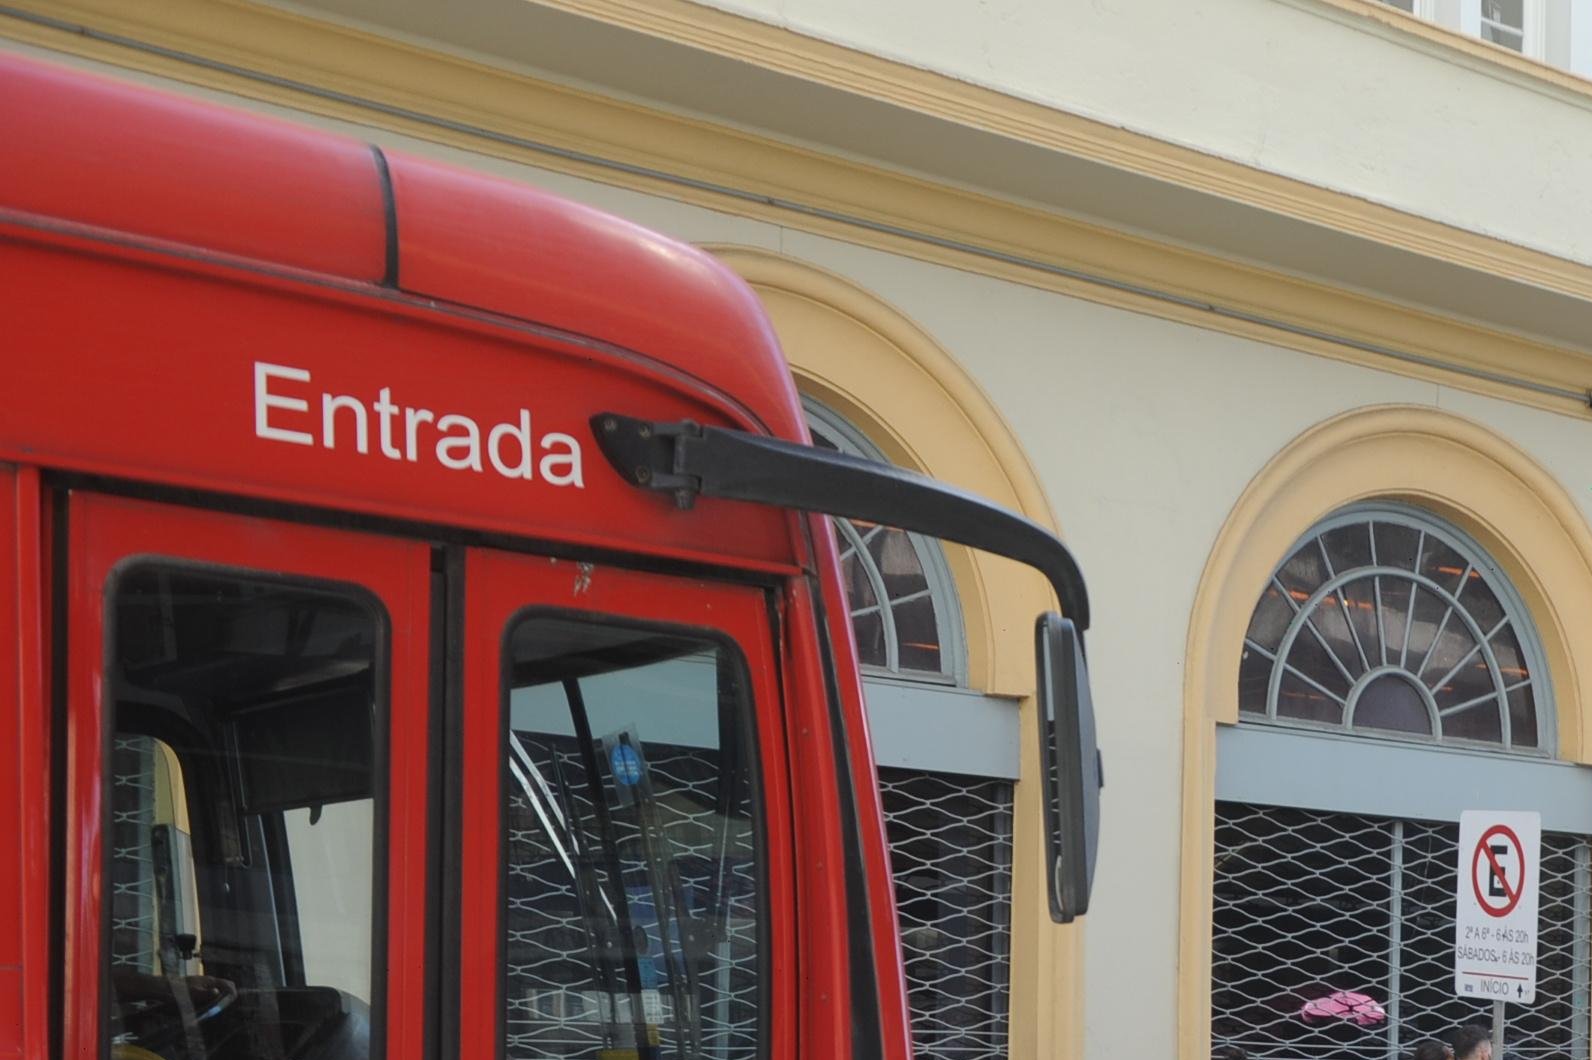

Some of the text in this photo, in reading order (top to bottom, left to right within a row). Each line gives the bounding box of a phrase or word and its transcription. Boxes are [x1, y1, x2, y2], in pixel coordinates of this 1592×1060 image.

[253, 360, 585, 489] Entrada
[1474, 927, 1480, 939] A
[1496, 929, 1501, 941] 6
[1515, 930, 1529, 943] 20h
[1457, 945, 1496, 962] SÁBADOS
[1502, 950, 1507, 963] 6
[1521, 952, 1534, 966] 20h
[1480, 978, 1509, 995] INÍCIO
